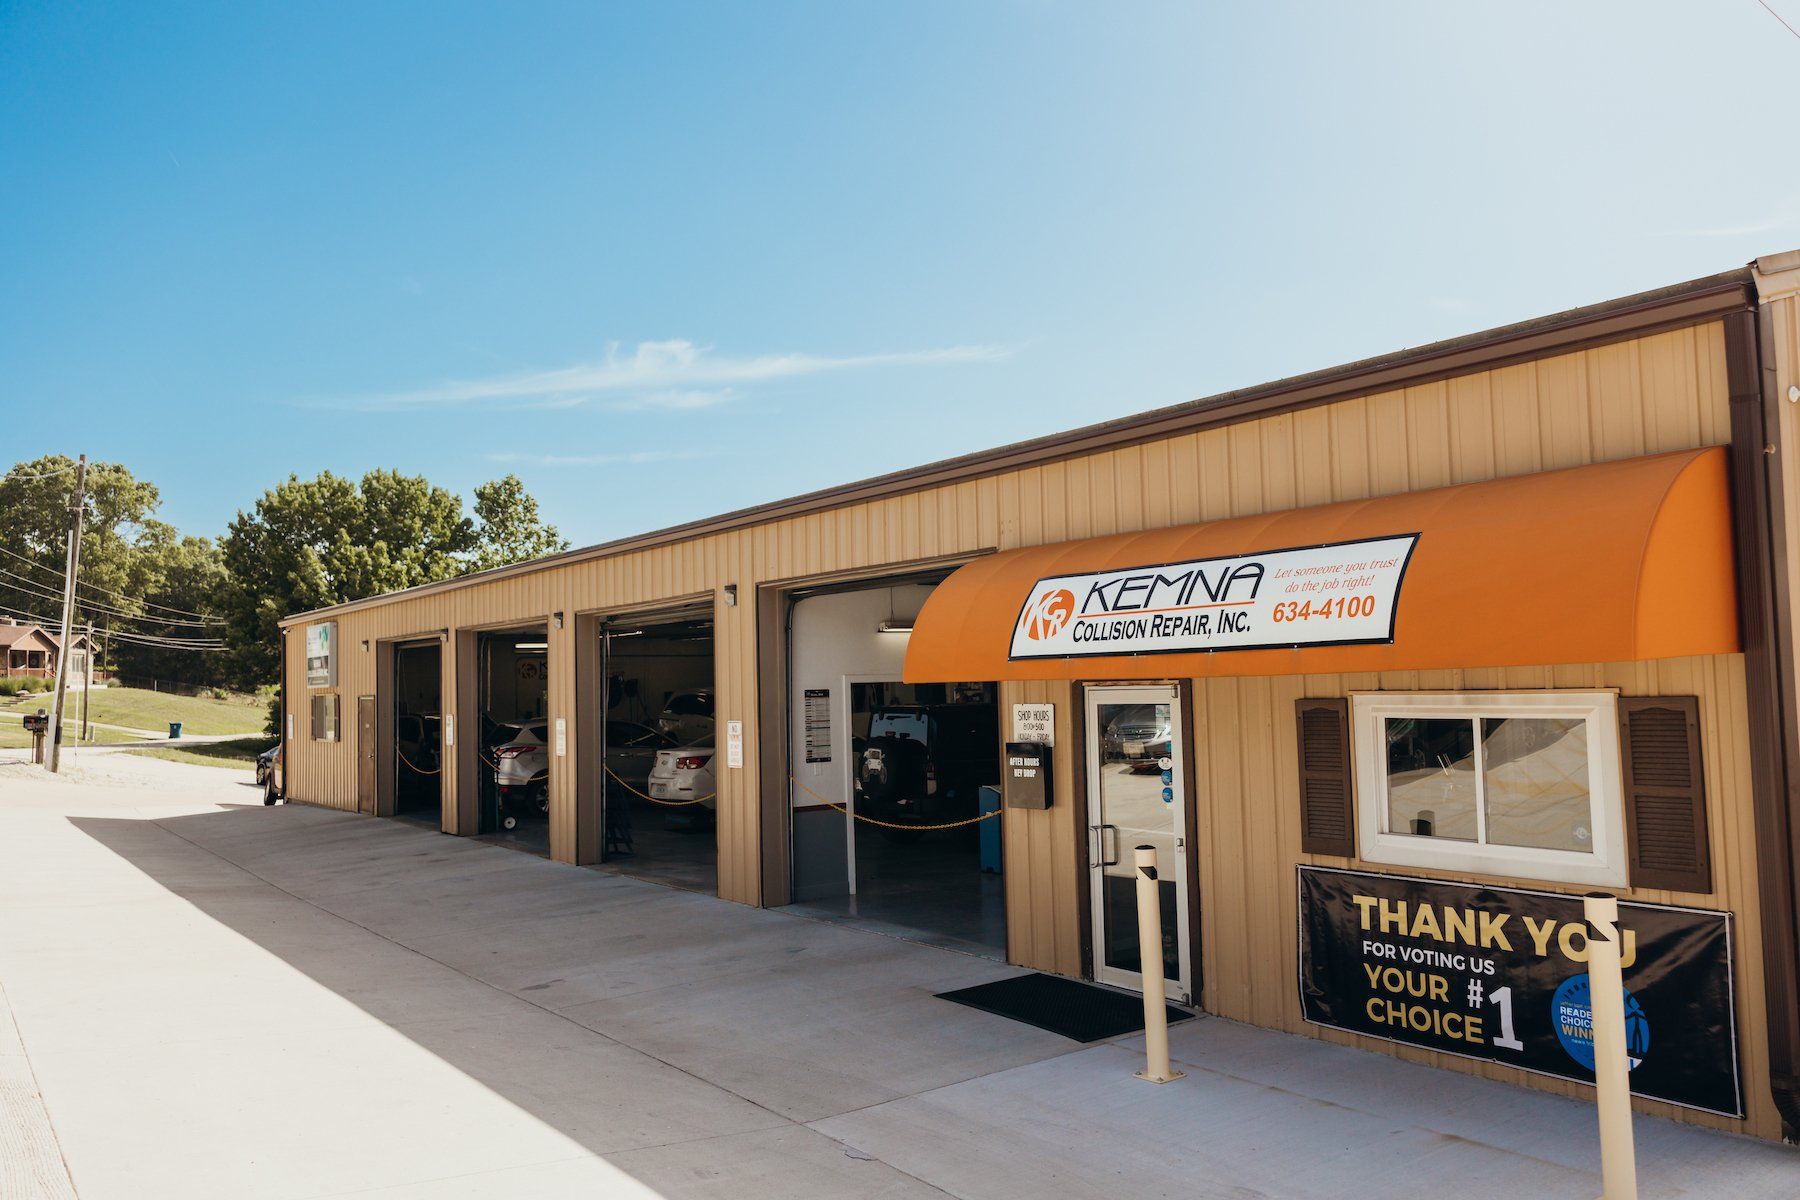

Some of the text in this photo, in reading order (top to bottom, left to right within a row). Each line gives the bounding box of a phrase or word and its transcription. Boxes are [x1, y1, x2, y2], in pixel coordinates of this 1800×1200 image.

[1274, 558, 1399, 579] Let someone you trust
[1284, 574, 1375, 594] do the job right!
[1081, 562, 1265, 614] KEMNA
[1073, 609, 1251, 643] COLLISION REPAIR, INC.
[1272, 595, 1376, 623] 634-4100
[1352, 894, 1513, 952] THANK
[1362, 940, 1495, 976] FOR VOTING US
[1363, 962, 1449, 1003] YOUR
[1366, 997, 1485, 1045] CHOICE
[1560, 1006, 1592, 1020] READE
[1560, 1015, 1593, 1029] CHOIC
